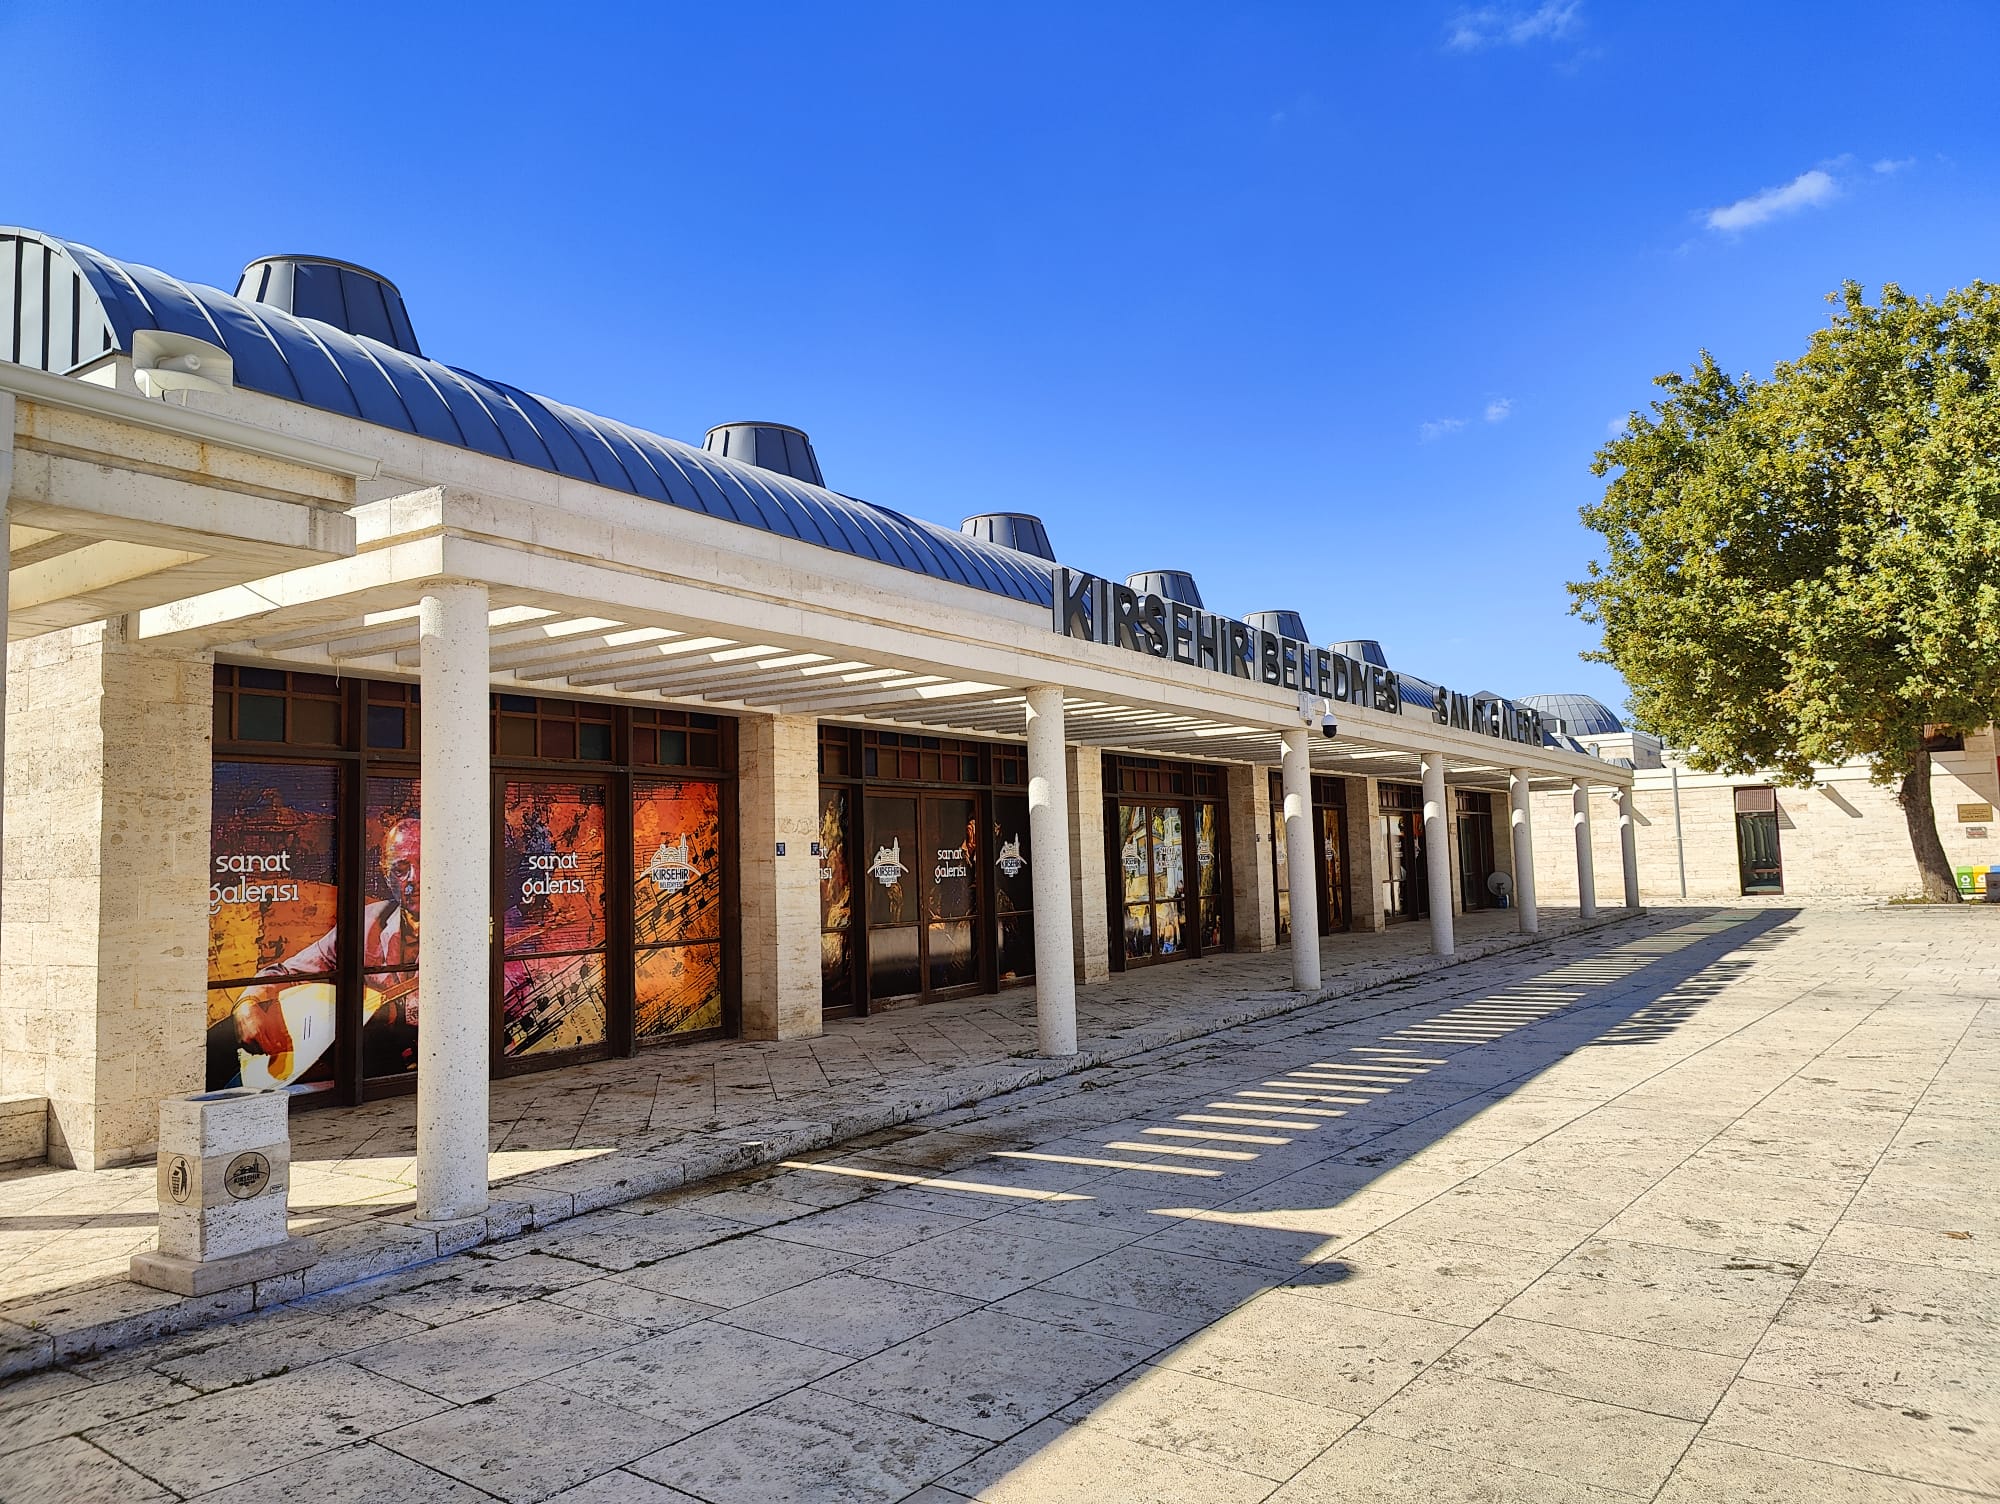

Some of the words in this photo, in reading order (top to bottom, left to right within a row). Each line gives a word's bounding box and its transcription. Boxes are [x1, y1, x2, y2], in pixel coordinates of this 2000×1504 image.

[215, 850, 291, 873] sanat
[528, 851, 579, 870] sanat
[937, 848, 963, 860] sanat
